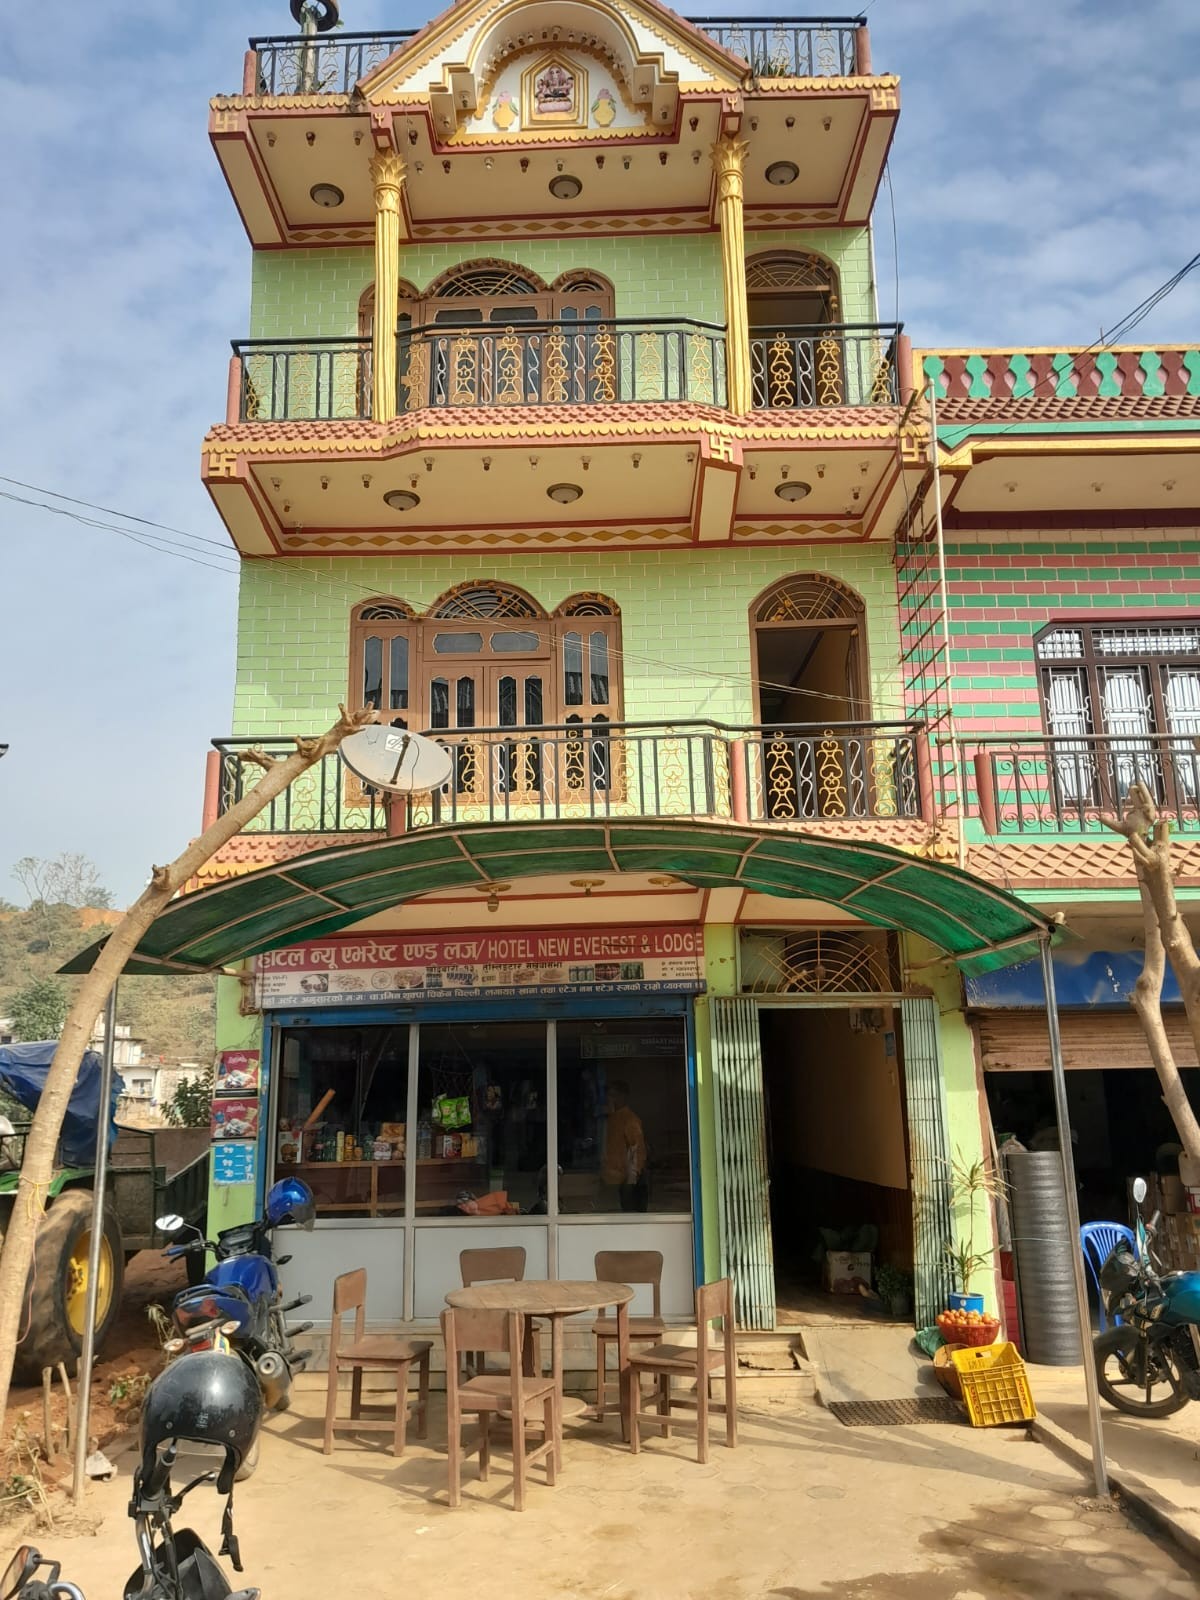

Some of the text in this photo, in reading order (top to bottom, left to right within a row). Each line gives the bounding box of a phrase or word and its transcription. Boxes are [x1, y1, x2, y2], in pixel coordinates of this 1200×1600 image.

[311, 947, 339, 969] न्यू
[403, 944, 439, 960] एण्ड
[488, 932, 703, 959] HOTEL NEW EVEREST & LODGE
